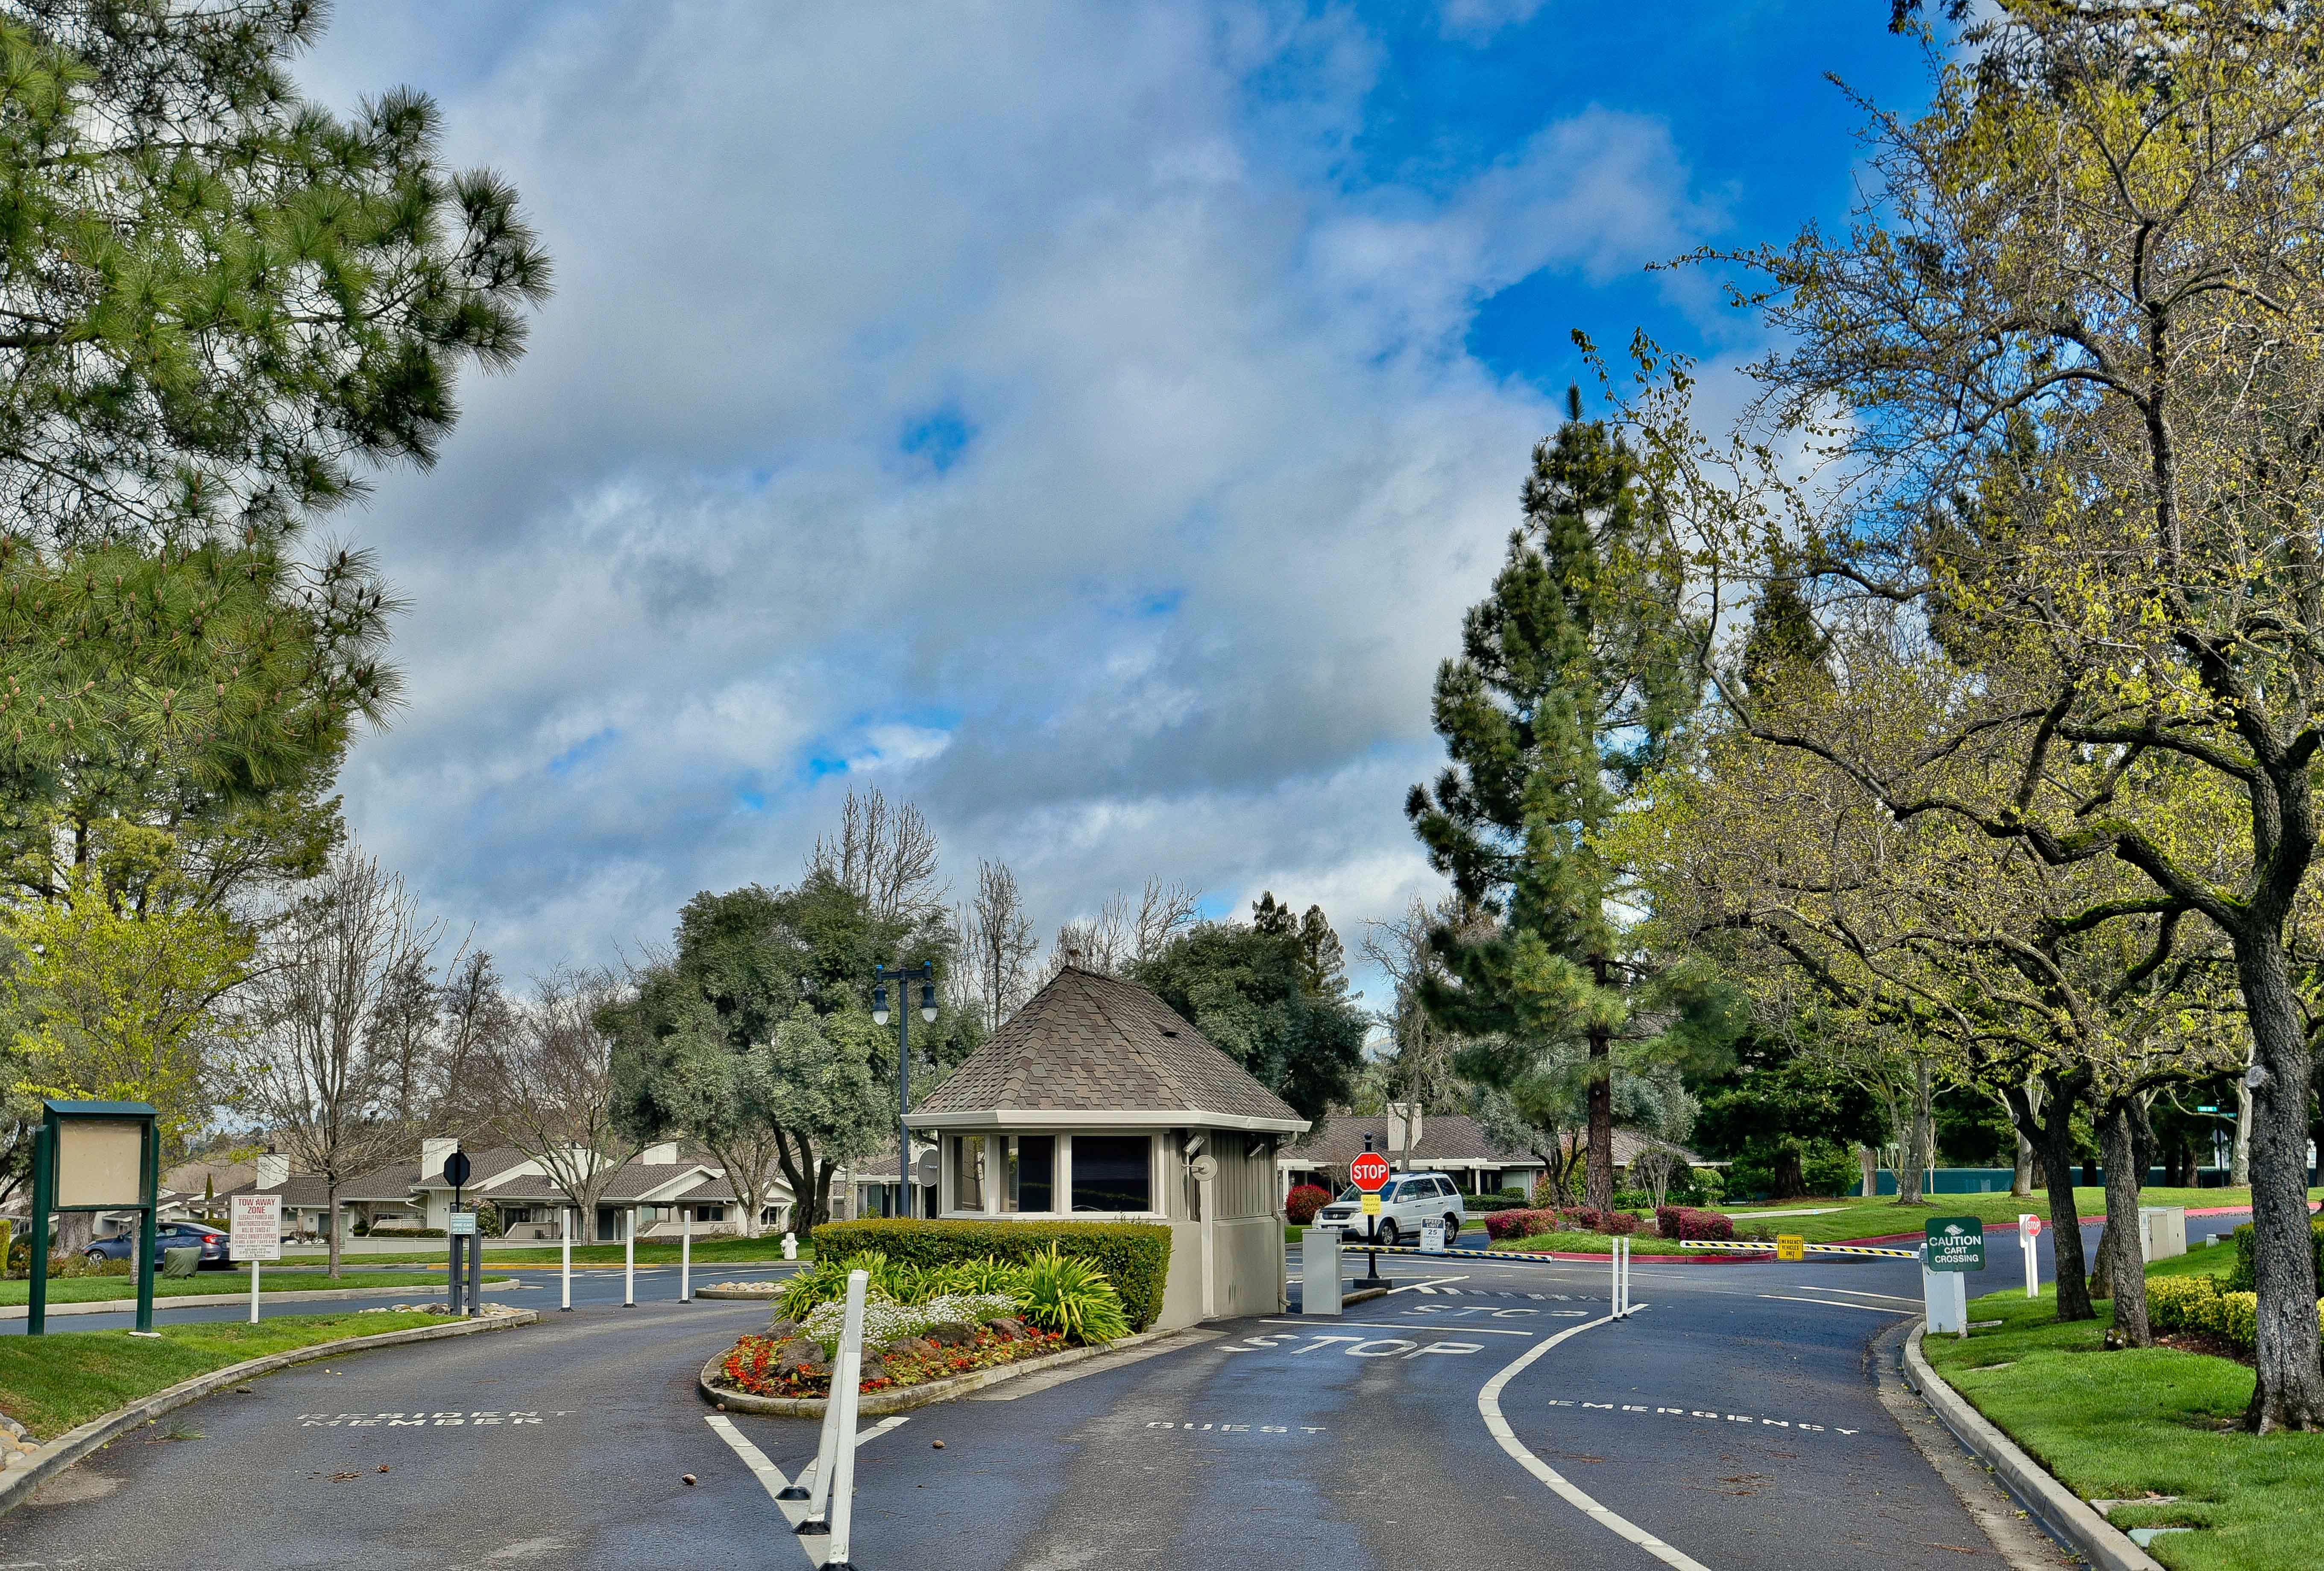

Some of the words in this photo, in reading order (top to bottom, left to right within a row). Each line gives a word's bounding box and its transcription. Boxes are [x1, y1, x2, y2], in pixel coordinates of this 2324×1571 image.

[1353, 1164, 1386, 1179] STOP
[2027, 1220, 2040, 1230] STOP
[1929, 1236, 1981, 1246] CAUTION
[1935, 1254, 1978, 1263] CROSSING
[1399, 1305, 1589, 1318] STOP
[1214, 1334, 1485, 1360] STOP
[296, 1411, 577, 1419] RESIDENT
[1548, 1399, 1860, 1435] EMERGENCY
[302, 1418, 543, 1426] MEMBER
[1146, 1422, 1326, 1434] GUEST
